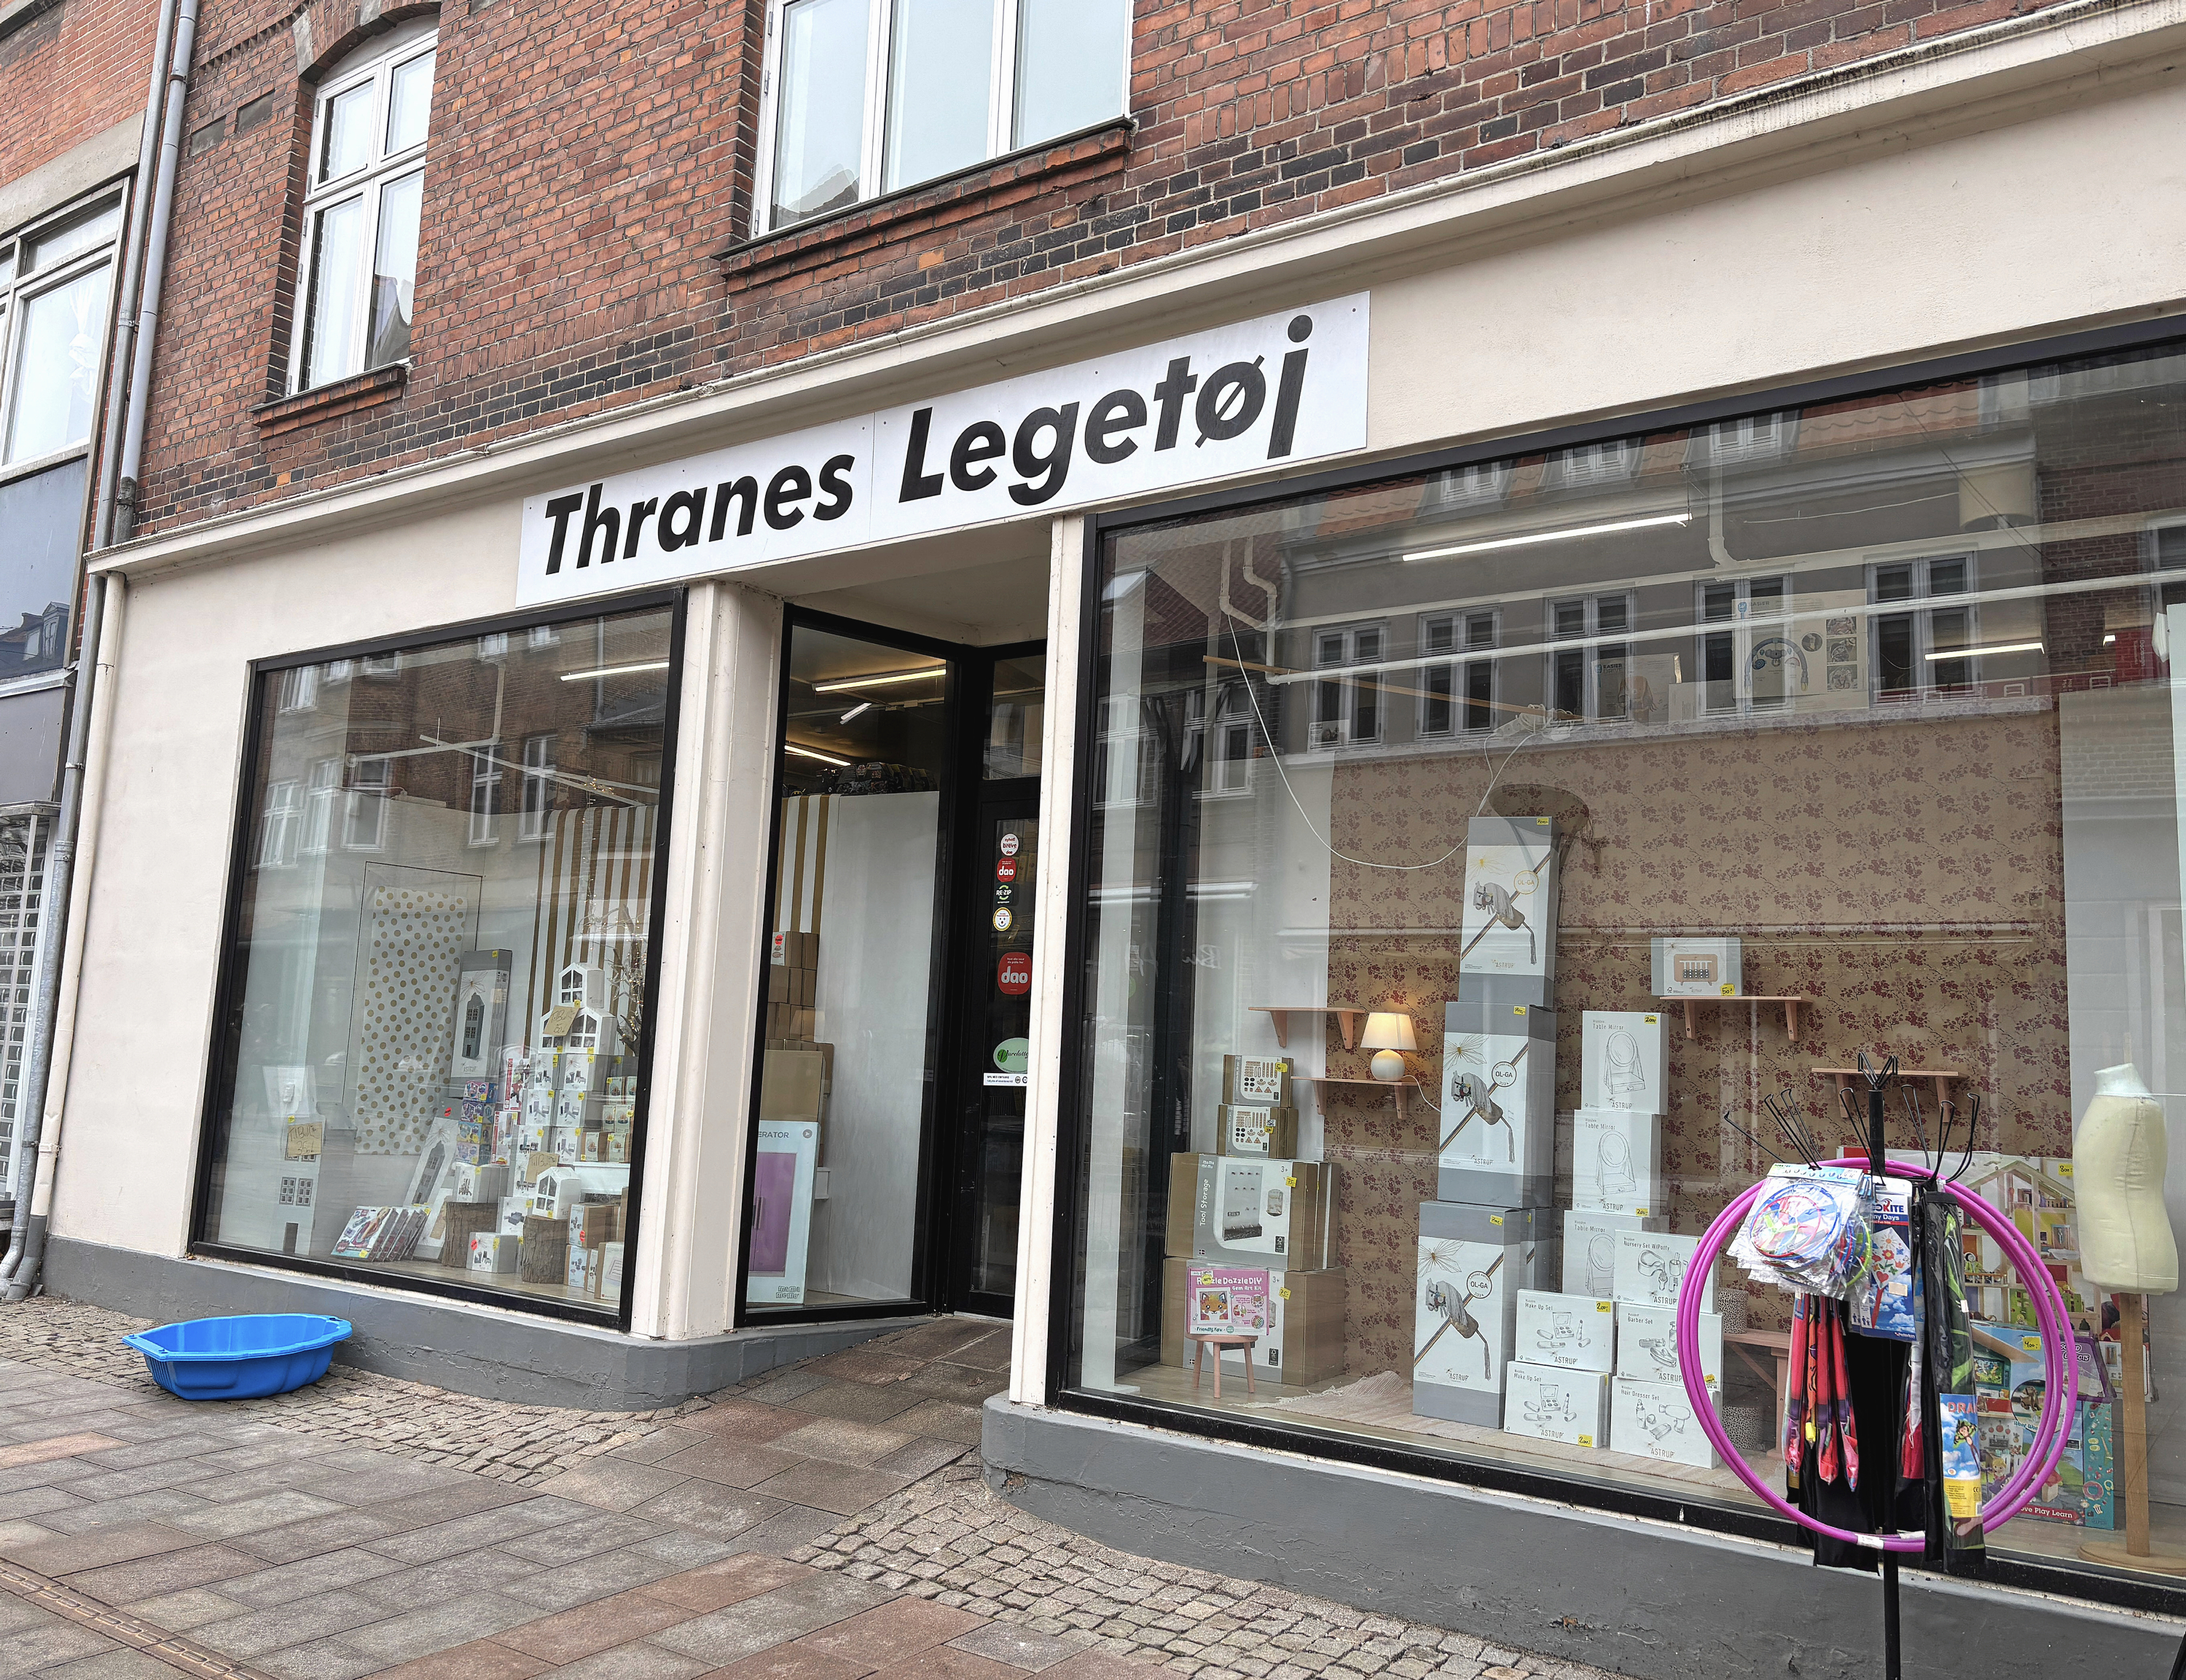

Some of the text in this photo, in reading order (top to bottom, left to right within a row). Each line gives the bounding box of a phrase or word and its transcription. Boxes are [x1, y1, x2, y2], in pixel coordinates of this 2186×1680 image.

[545, 314, 1314, 575] Thranes Legetøj
[998, 865, 1014, 876] dao
[1000, 965, 1028, 984] dao
[1611, 1102, 1634, 1110] ASTRUP
[1201, 1179, 1210, 1209] Storage
[1602, 1203, 1623, 1211] ASTRUP
[1248, 1277, 1262, 1285] DIY
[1470, 1281, 1489, 1289] OL-GA
[1653, 1296, 1677, 1305] ASTRUP
[1554, 1356, 1578, 1365] ASTRUP
[1449, 1373, 1469, 1381] ASTRUP
[1658, 1372, 1682, 1382] ASTRUP
[1632, 1391, 1650, 1399] Dresser
[1540, 1429, 1564, 1439] ASTRUP
[1650, 1447, 1675, 1458] ASTRUP
[2034, 1507, 2050, 1516] Play
[2052, 1509, 2073, 1518] Learn
